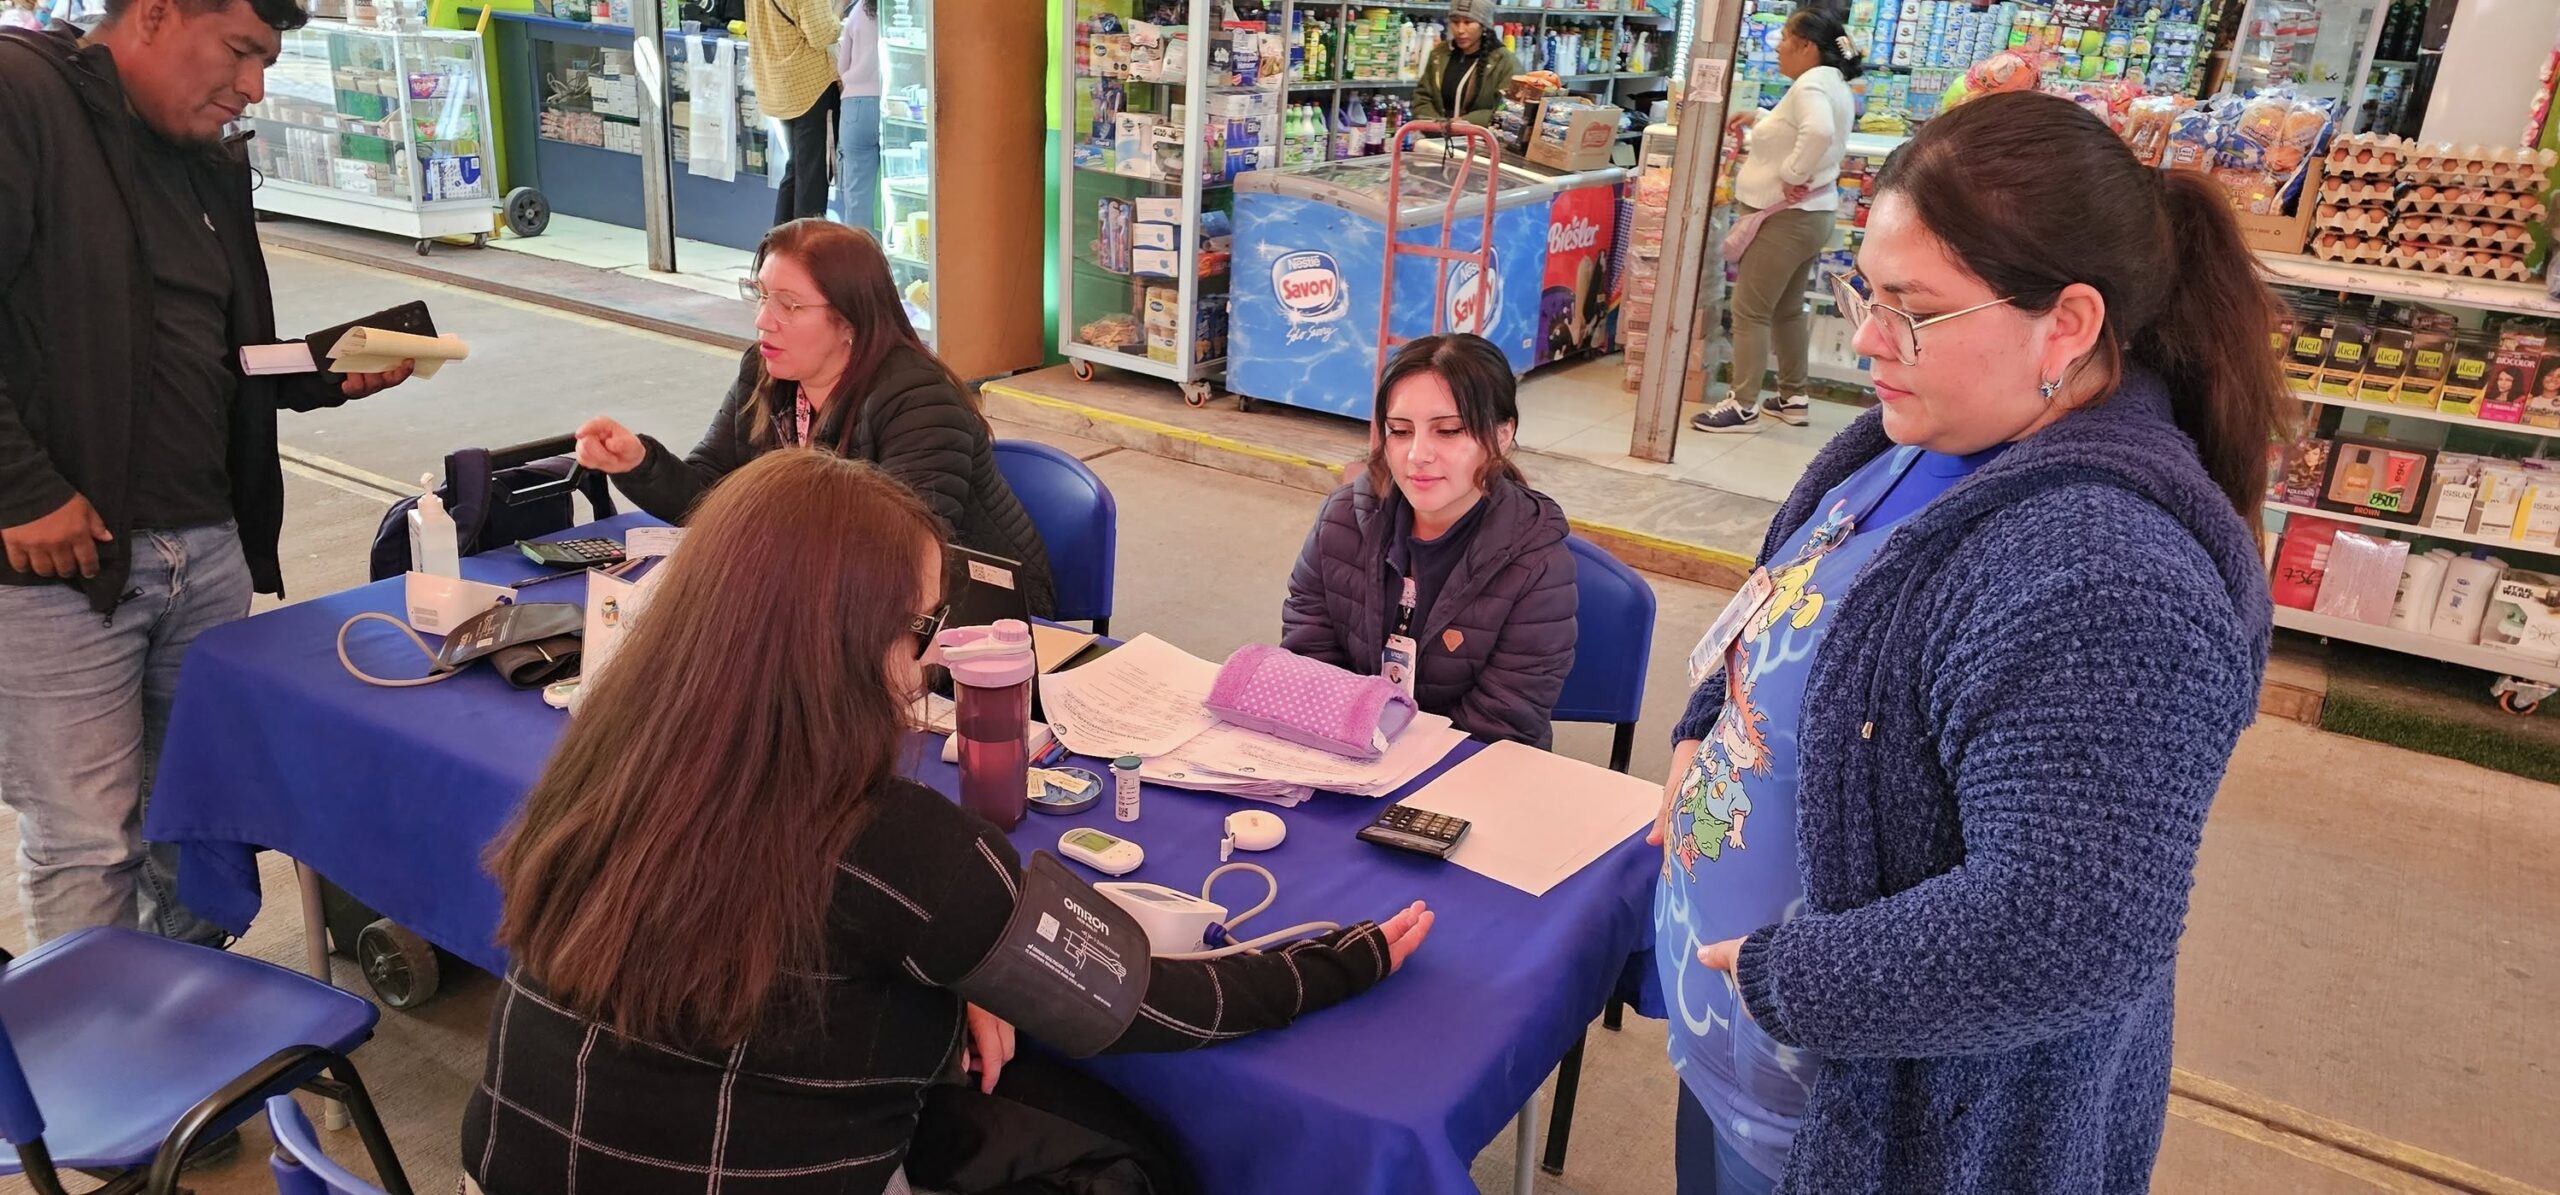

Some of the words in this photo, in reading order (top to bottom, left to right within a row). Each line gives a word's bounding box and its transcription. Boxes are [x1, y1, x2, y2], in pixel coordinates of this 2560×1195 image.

[1547, 216, 1600, 254] Bresler
[1282, 277, 1333, 300] Savory
[1454, 278, 1495, 328] Savy
[2353, 506, 2380, 517] BROWN
[2506, 584, 2533, 593] STAR
[1064, 897, 1110, 936] OMRON
